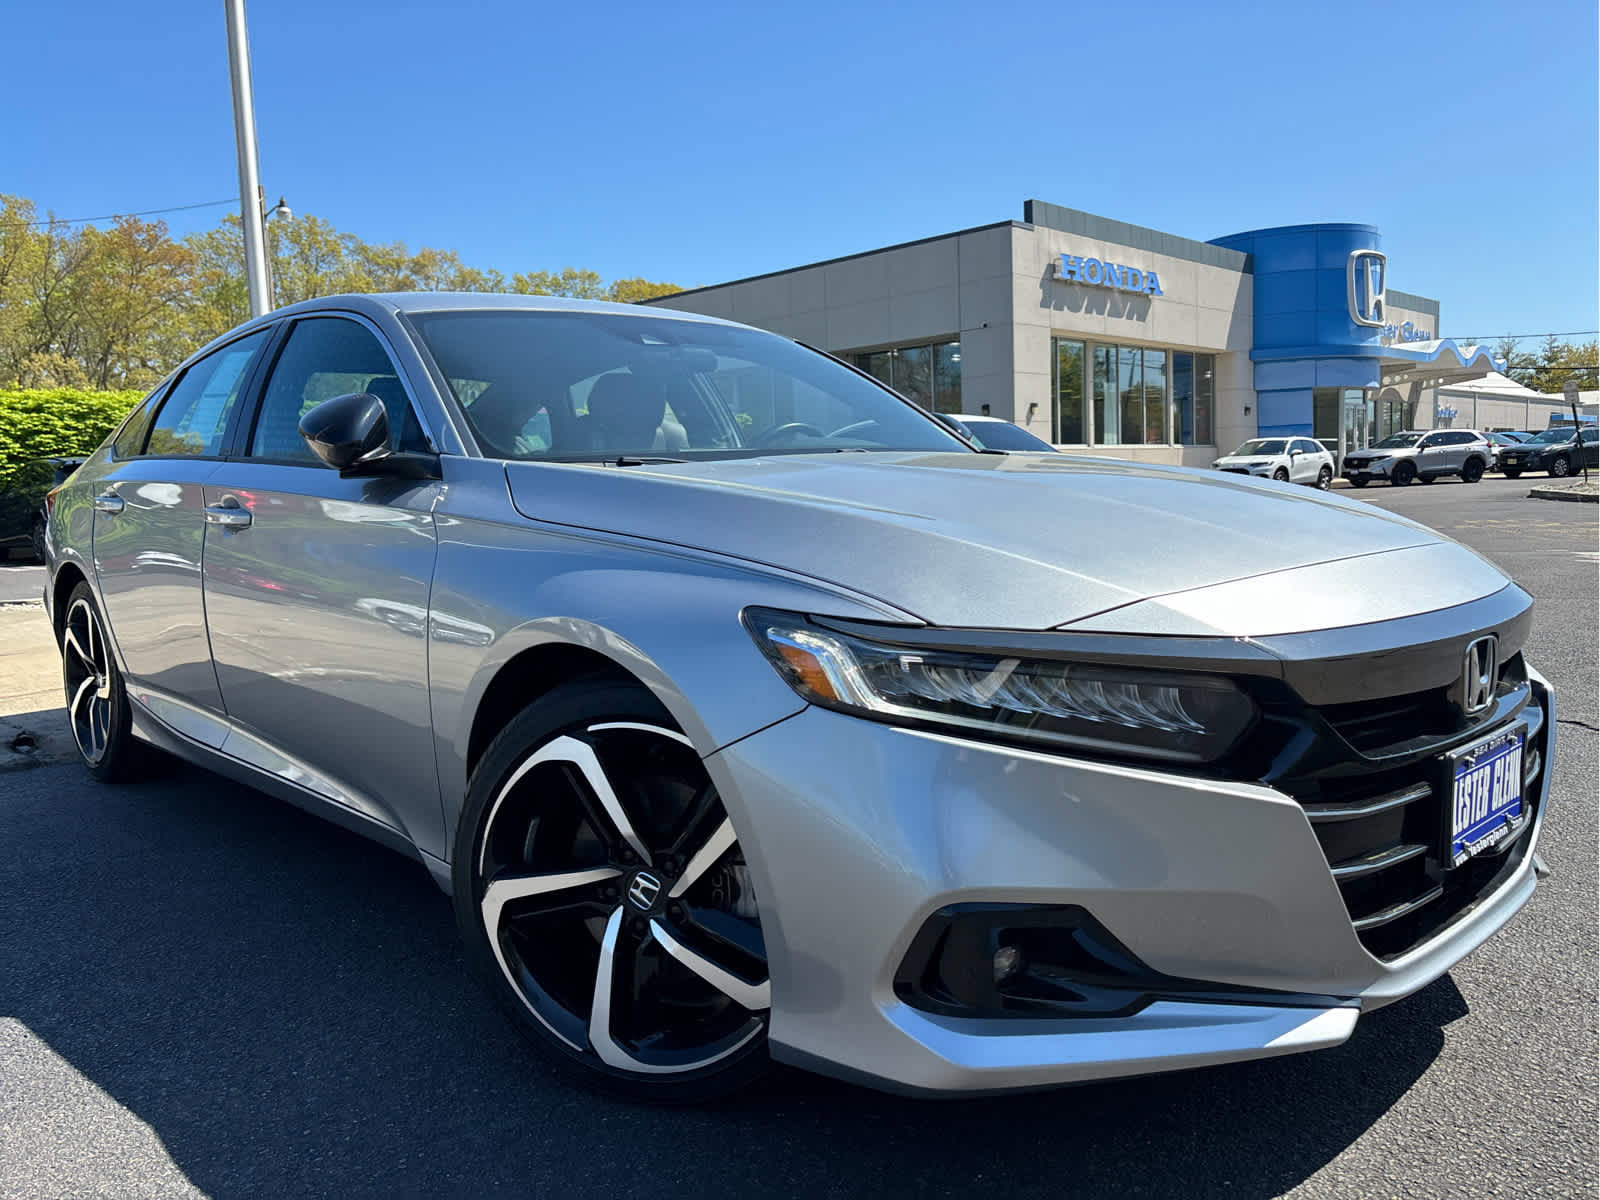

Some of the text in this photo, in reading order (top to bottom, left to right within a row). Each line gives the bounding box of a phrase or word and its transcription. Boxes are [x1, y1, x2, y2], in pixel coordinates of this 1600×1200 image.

[1059, 253, 1164, 296] HONDA
[1453, 746, 1523, 837] LESTER GLENN
